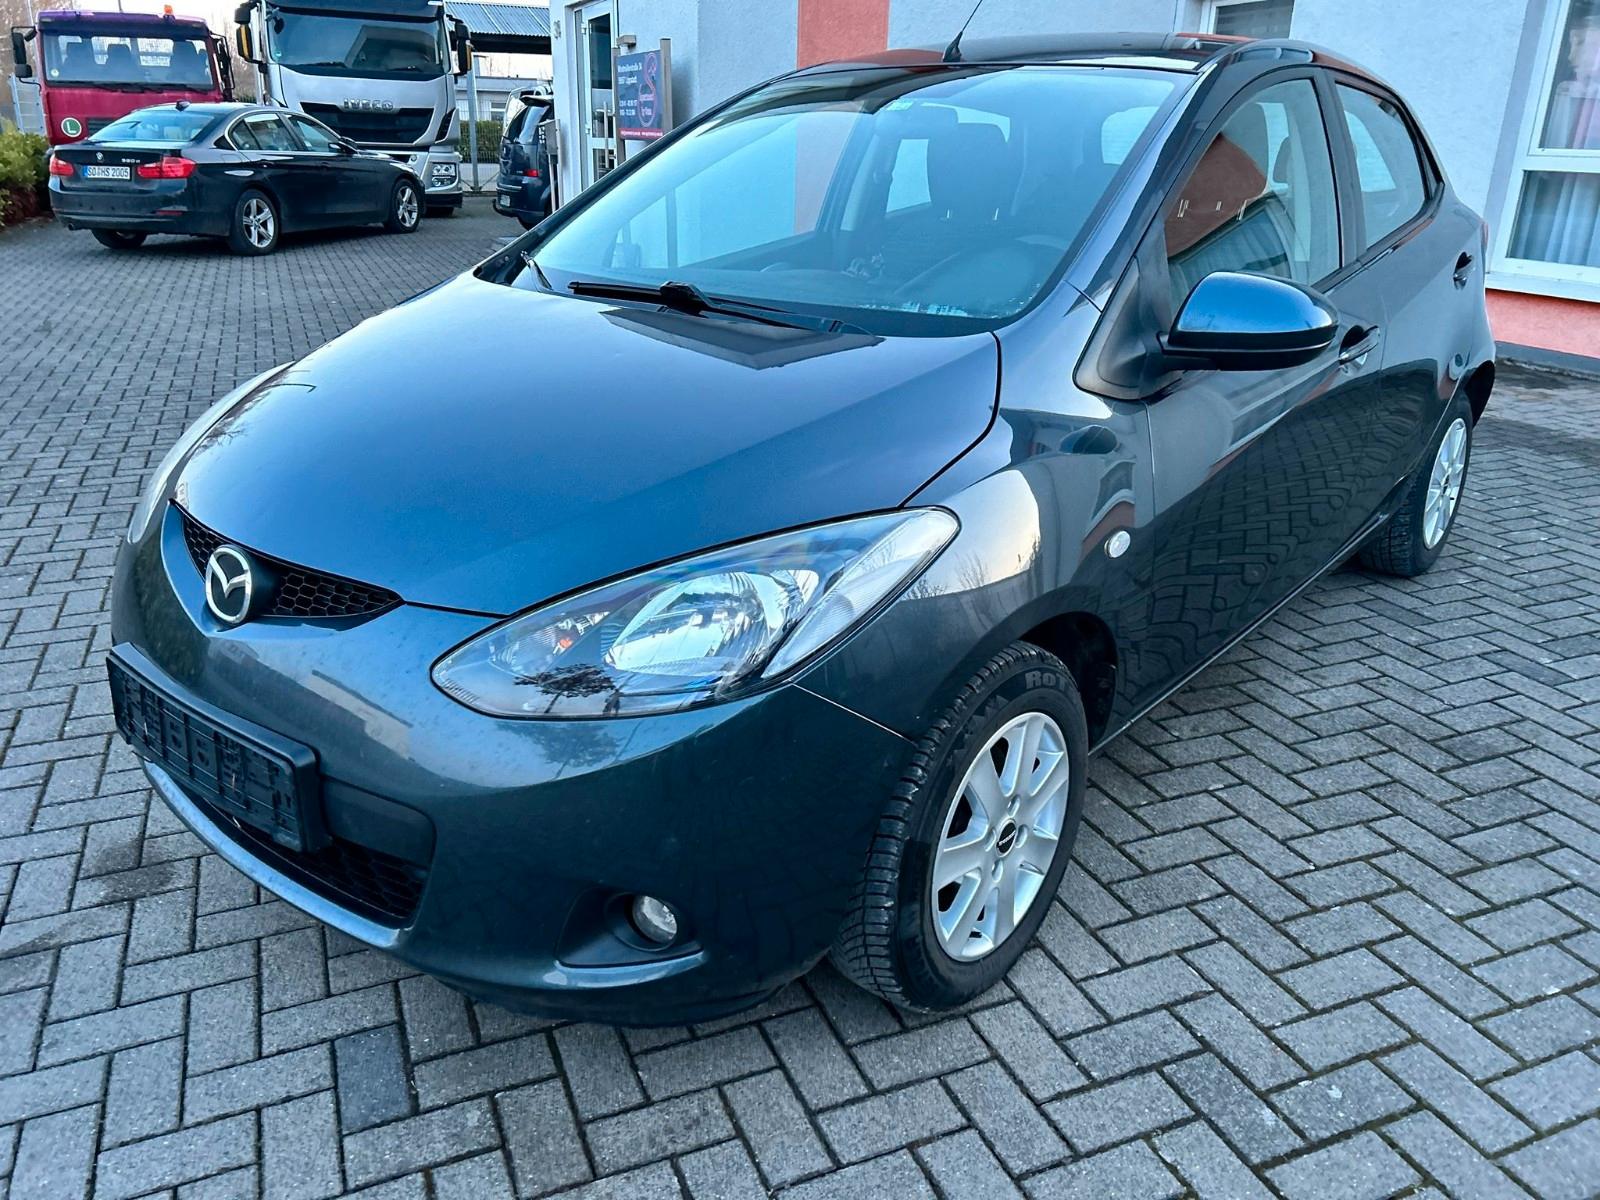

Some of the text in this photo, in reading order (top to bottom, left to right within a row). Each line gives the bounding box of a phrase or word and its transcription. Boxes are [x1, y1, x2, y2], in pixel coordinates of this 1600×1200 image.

[343, 98, 394, 111] IVECO
[66, 121, 77, 134] L
[101, 167, 110, 177] HS
[111, 167, 129, 178] 2005
